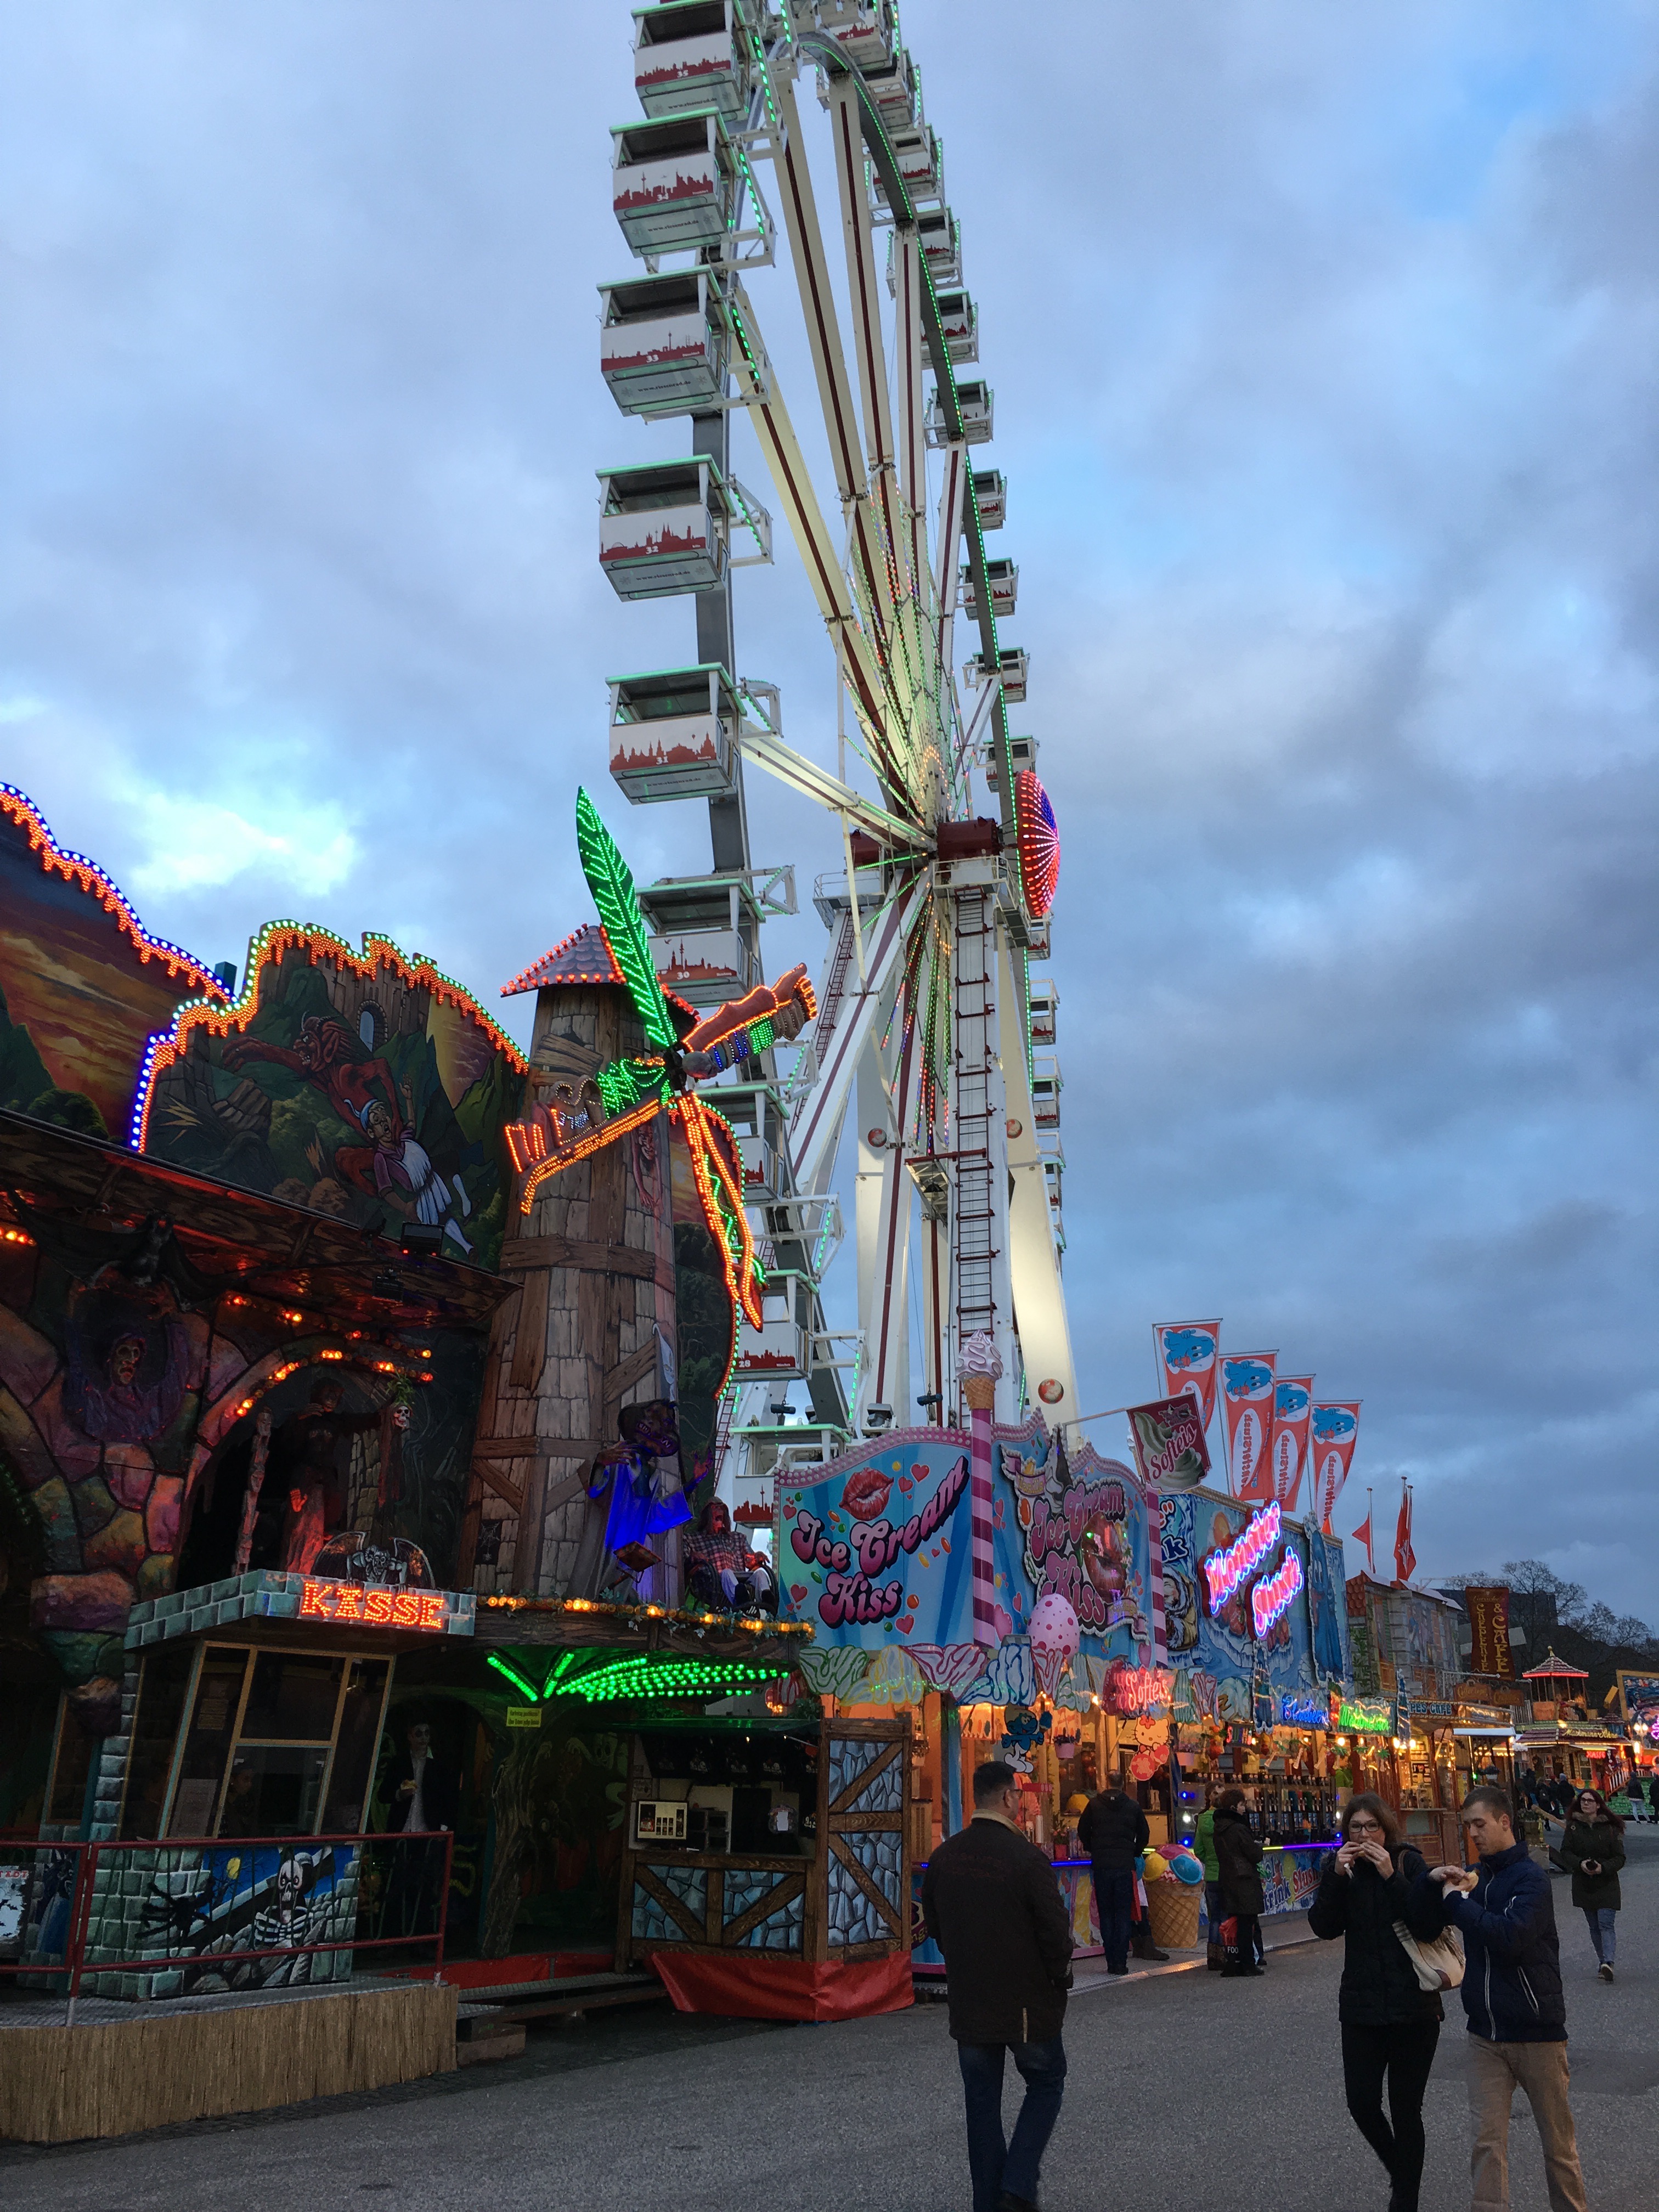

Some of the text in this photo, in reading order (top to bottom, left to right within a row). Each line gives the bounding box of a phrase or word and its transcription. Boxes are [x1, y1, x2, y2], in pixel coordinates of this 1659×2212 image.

[677, 70, 689, 78] 35
[668, 97, 717, 109] www.riesenrad.de
[657, 193, 669, 201] 34
[648, 219, 699, 232] www.riesenrad.de
[646, 354, 659, 363] 33
[638, 381, 691, 392] www.riesenrad.de
[646, 545, 658, 555] 32
[636, 571, 691, 580] www.riesenrad.de
[656, 756, 669, 764] 31
[676, 971, 690, 980] 30
[738, 1359, 751, 1368] 28
[1150, 1423, 1197, 1480] Softeis
[791, 1455, 970, 1578] Ice Cream
[1204, 1501, 1280, 1614] Monster
[1042, 1551, 1105, 1624] Kiss
[1252, 1546, 1302, 1637] Slush
[301, 1581, 444, 1629] KASSE
[819, 1572, 903, 1628] Kiss
[1493, 1603, 1503, 1613] &
[1126, 1668, 1169, 1711] Softeis
[1410, 1703, 1427, 1714] PES
